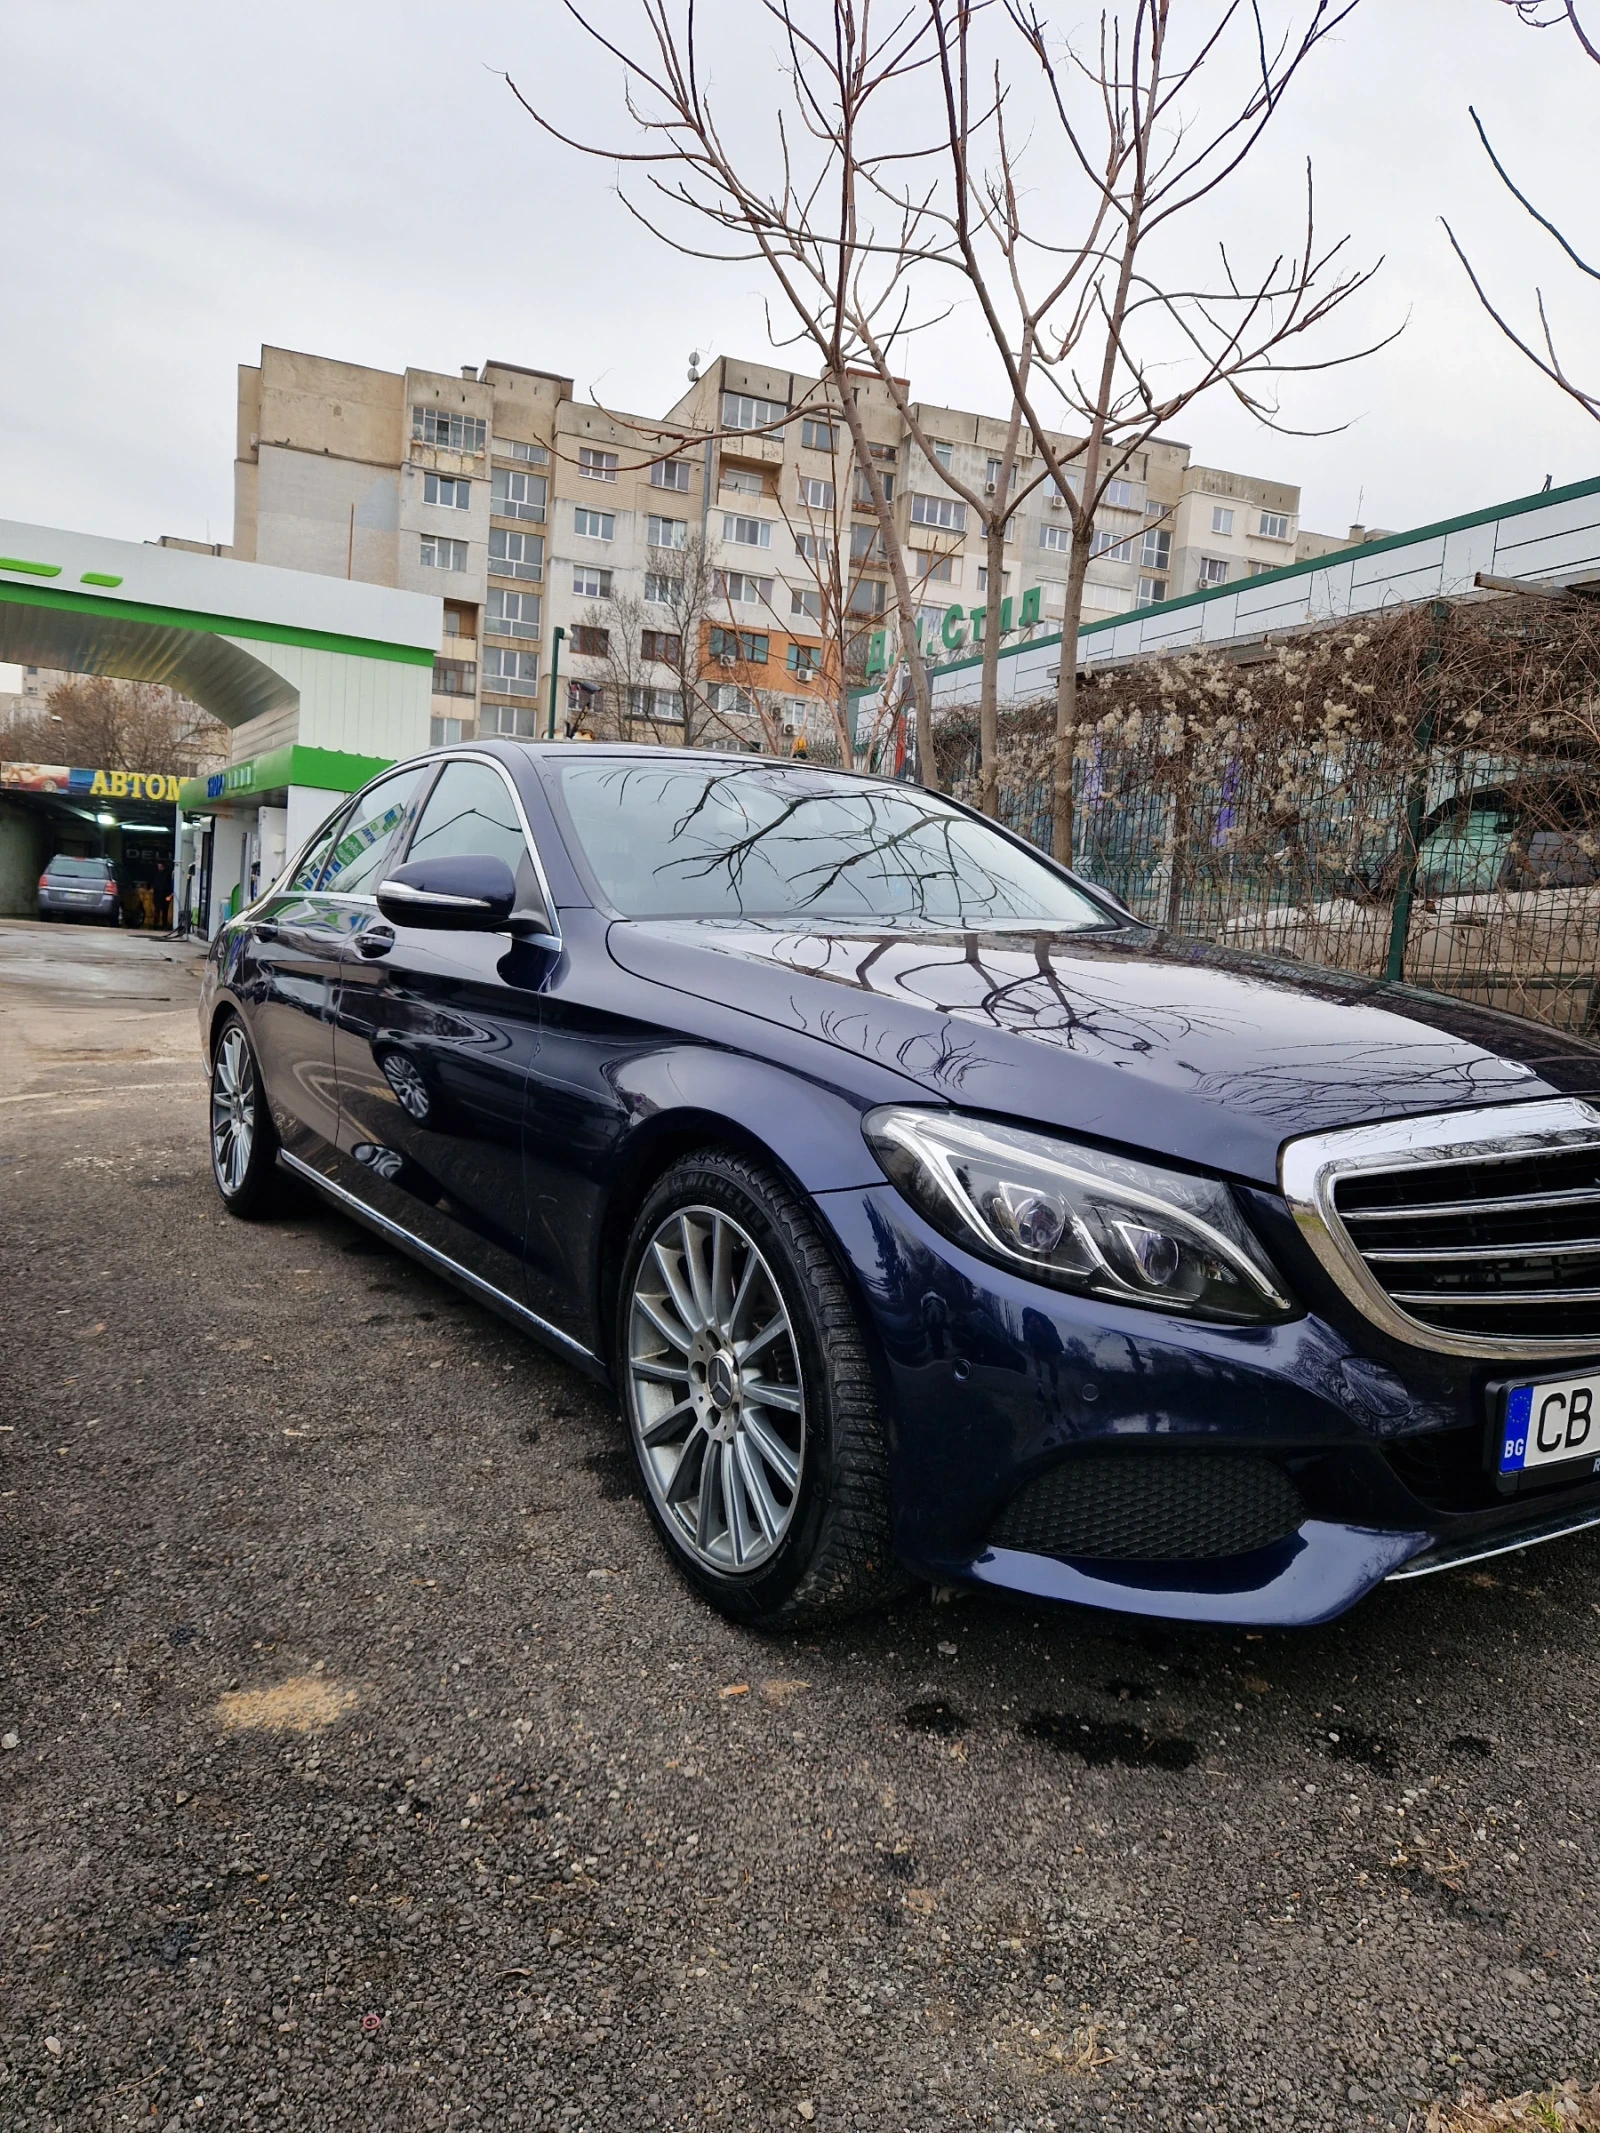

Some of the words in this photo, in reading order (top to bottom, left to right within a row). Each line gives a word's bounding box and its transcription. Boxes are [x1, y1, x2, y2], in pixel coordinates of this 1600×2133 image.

[685, 1172, 768, 1228] MICHELIN
[1504, 1438, 1525, 1458] BG
[1537, 1387, 1593, 1453] CB
